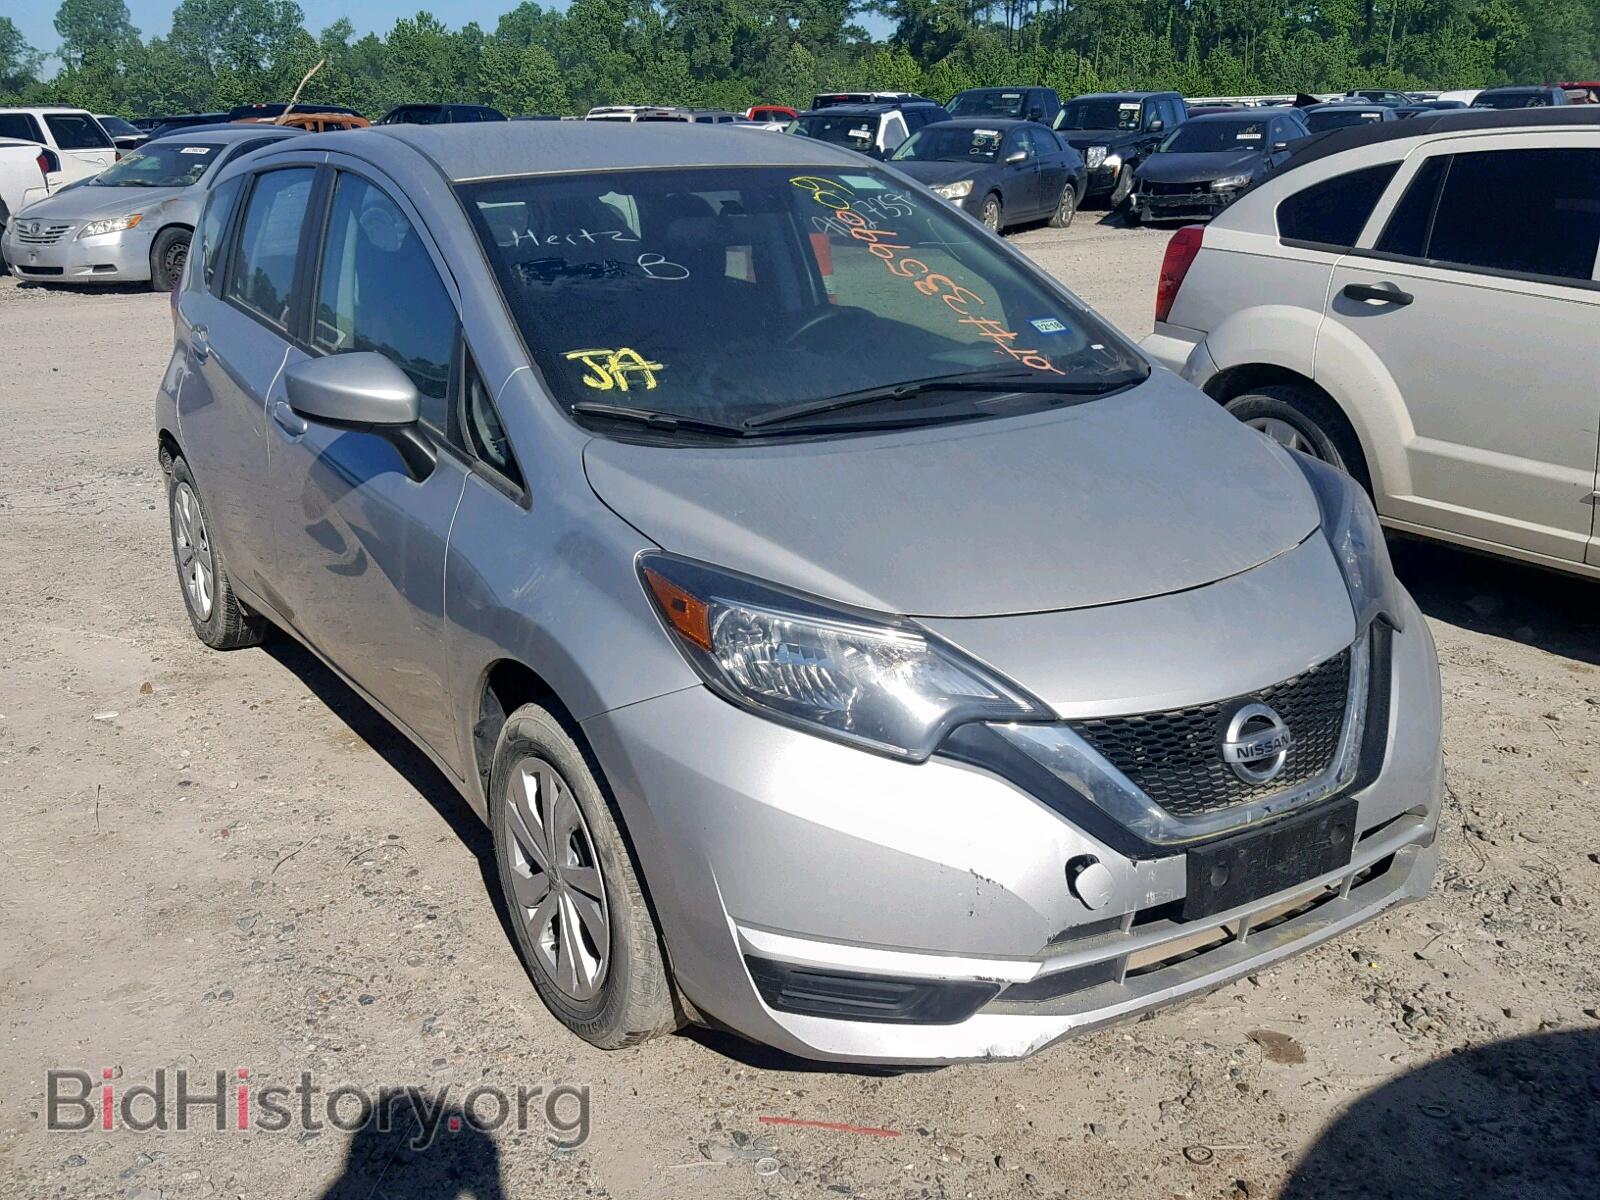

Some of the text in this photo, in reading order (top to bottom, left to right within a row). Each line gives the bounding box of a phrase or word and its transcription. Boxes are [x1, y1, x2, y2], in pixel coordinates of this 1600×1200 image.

[510, 228, 642, 247] Hertz
[637, 253, 690, 280] B
[560, 348, 670, 392] JA
[1236, 735, 1289, 759] NISSAN
